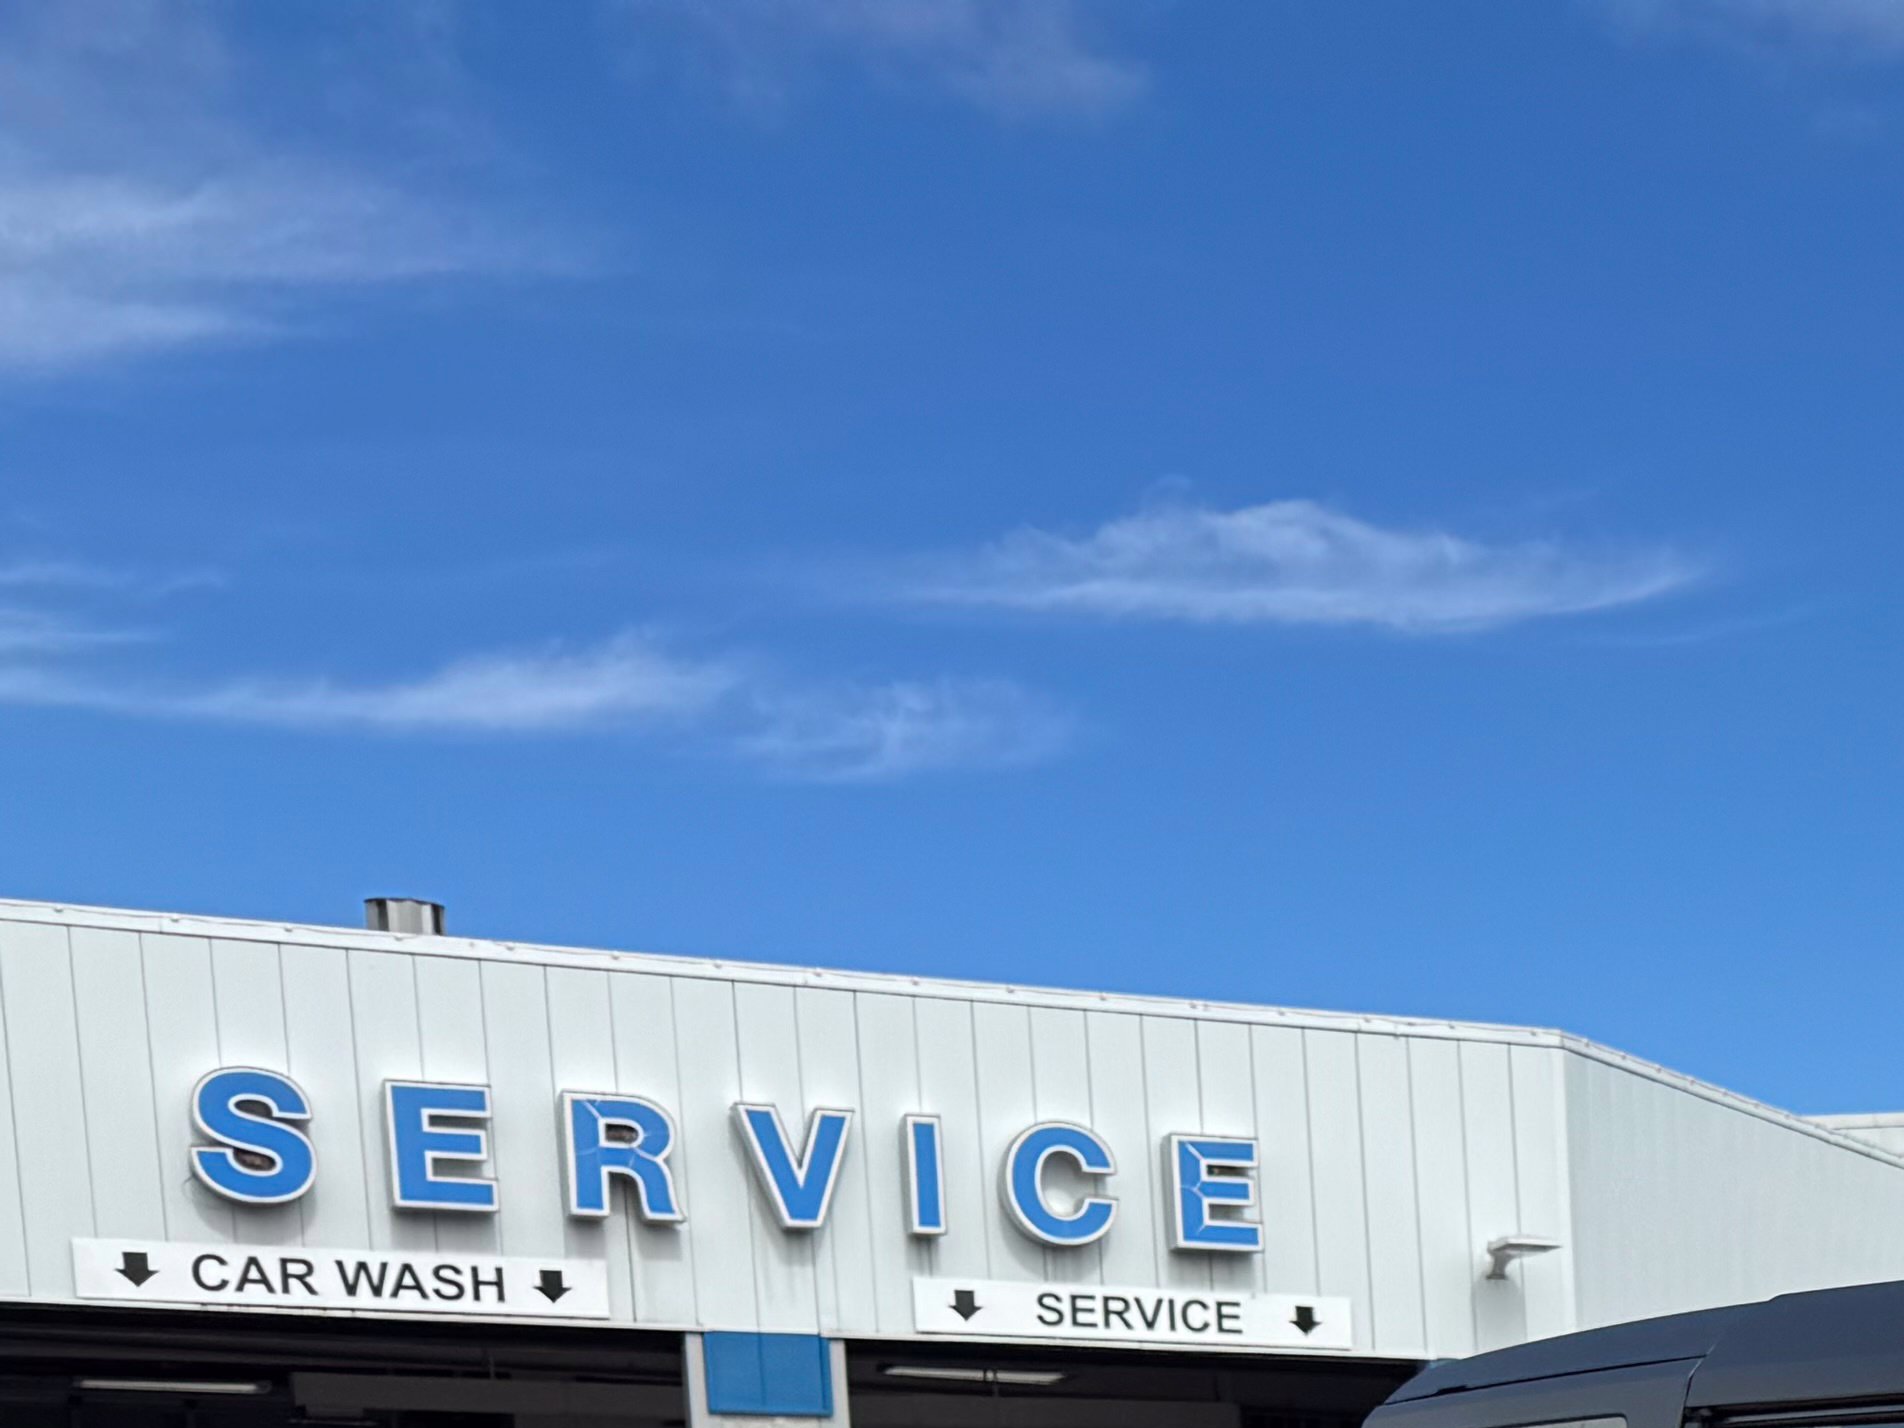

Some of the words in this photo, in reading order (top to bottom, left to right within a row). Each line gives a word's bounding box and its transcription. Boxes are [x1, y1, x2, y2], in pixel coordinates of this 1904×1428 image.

[191, 1065, 1267, 1253] SERVICE
[190, 1252, 320, 1297] CAR
[335, 1258, 507, 1304] WASH
[1036, 1291, 1244, 1336] SERVICE
